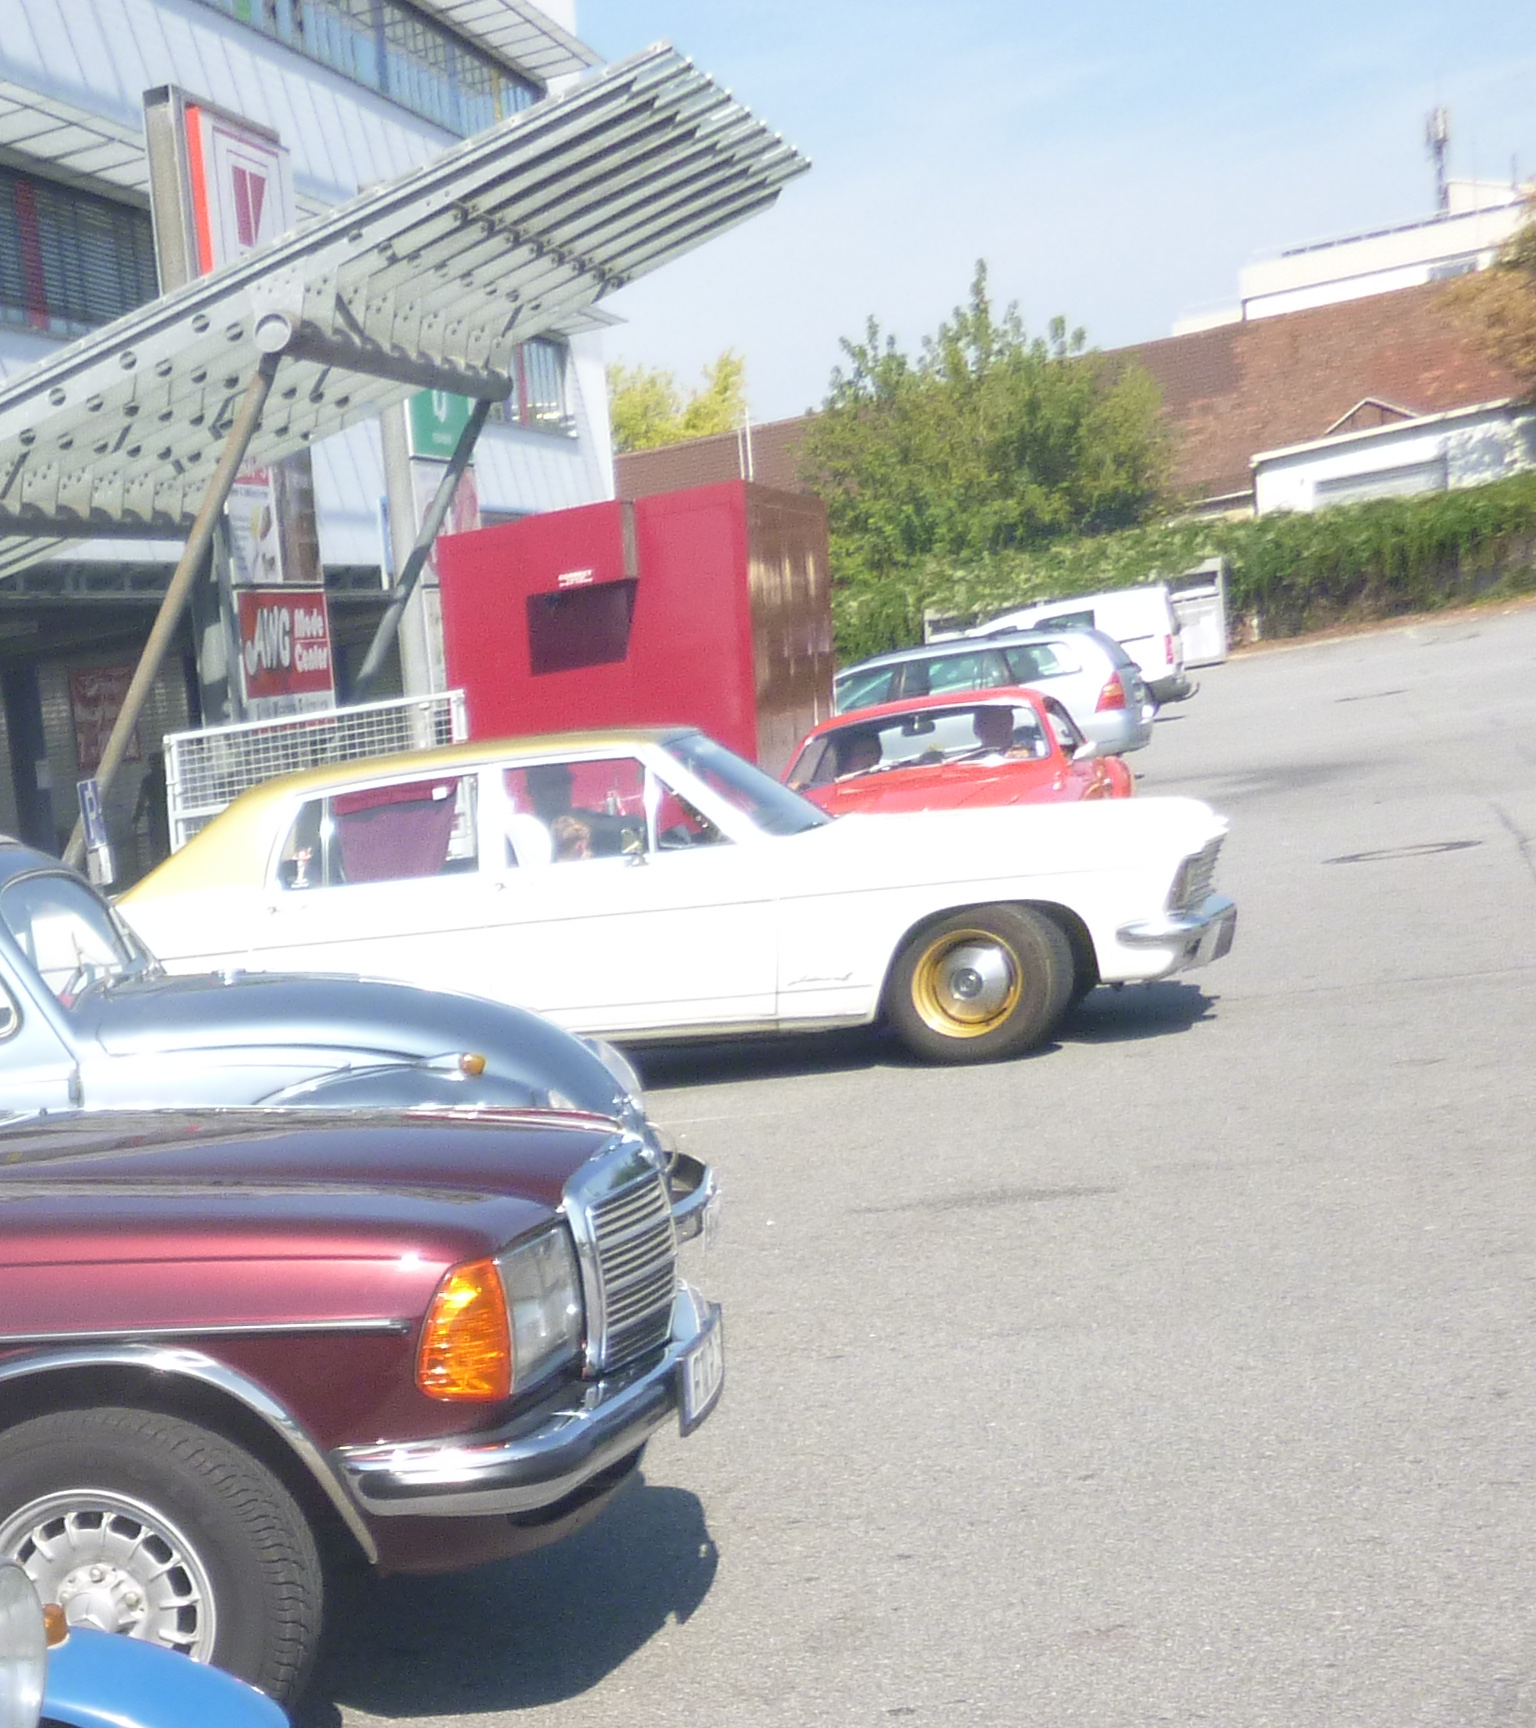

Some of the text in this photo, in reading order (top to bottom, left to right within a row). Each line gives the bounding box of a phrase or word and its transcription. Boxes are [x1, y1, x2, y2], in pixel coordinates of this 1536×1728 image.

[294, 607, 324, 638] Mode
[245, 605, 291, 677] AWG
[295, 643, 328, 673] Center
